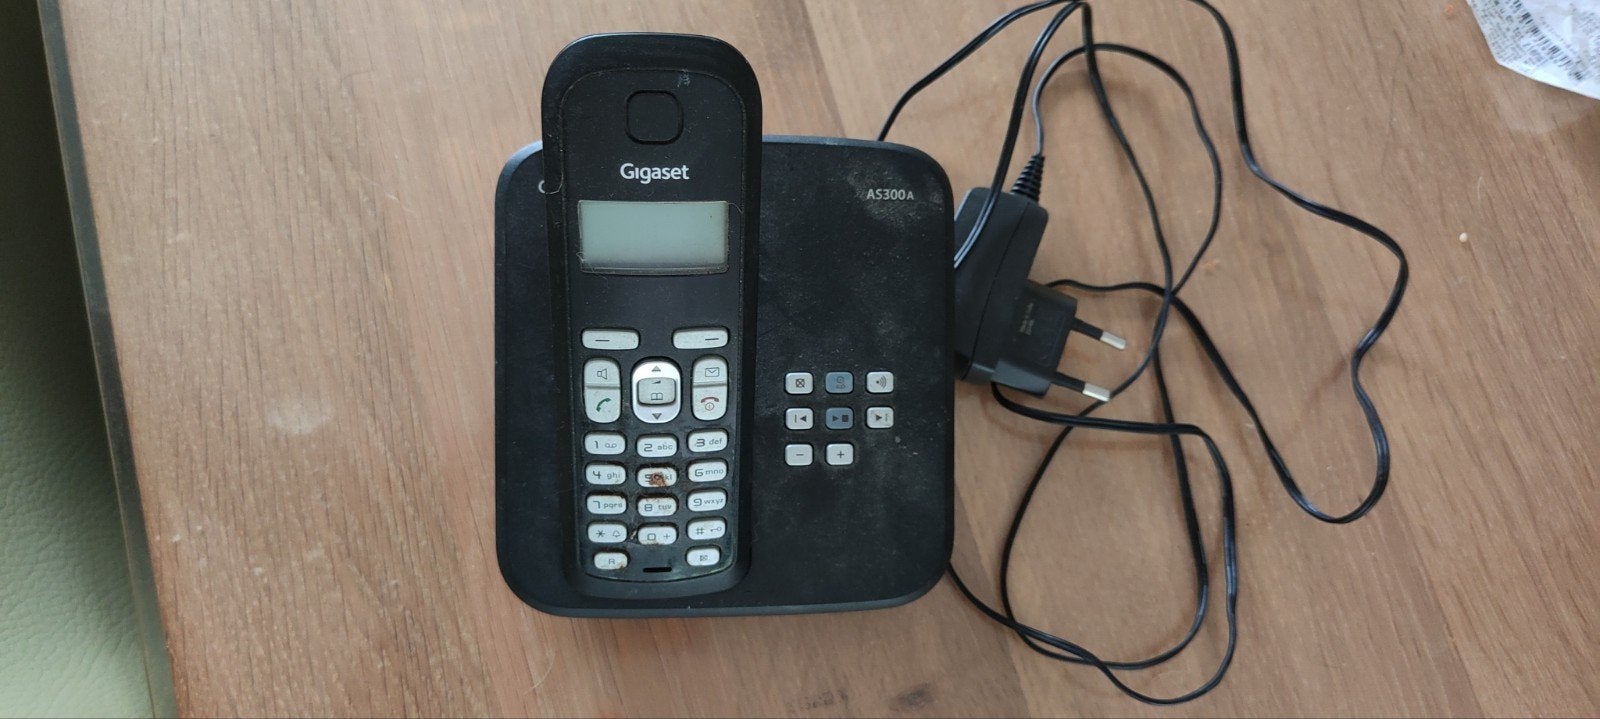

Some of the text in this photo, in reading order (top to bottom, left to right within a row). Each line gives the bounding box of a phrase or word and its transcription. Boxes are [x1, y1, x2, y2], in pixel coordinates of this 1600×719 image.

[620, 162, 690, 184] Gigaset
[594, 440, 599, 449] 1
[643, 442, 673, 452] 2 abc
[696, 437, 722, 447] 3 def
[592, 470, 621, 480] 4 ghi
[593, 500, 623, 510] 7 pqrs
[644, 503, 653, 512] 8
[693, 498, 724, 507] 9 wxyz
